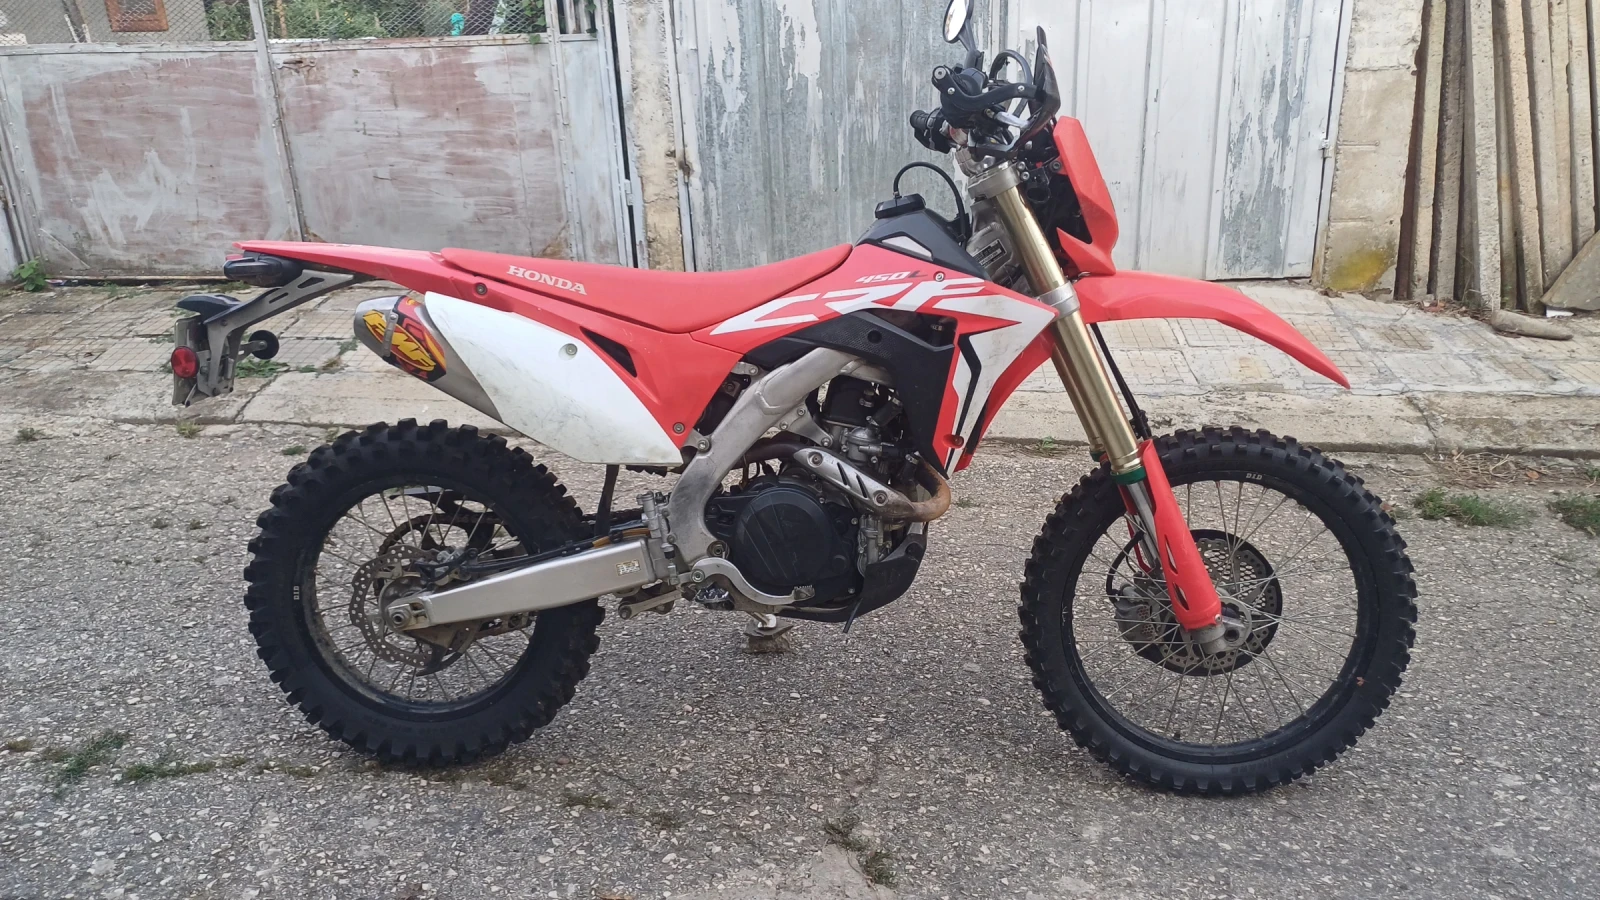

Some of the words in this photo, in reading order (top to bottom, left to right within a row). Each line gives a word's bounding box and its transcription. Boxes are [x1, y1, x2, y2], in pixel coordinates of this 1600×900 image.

[506, 265, 588, 296] HONDA
[855, 270, 928, 284] 450L
[709, 277, 986, 336] CRF
[362, 309, 436, 367] FMF
